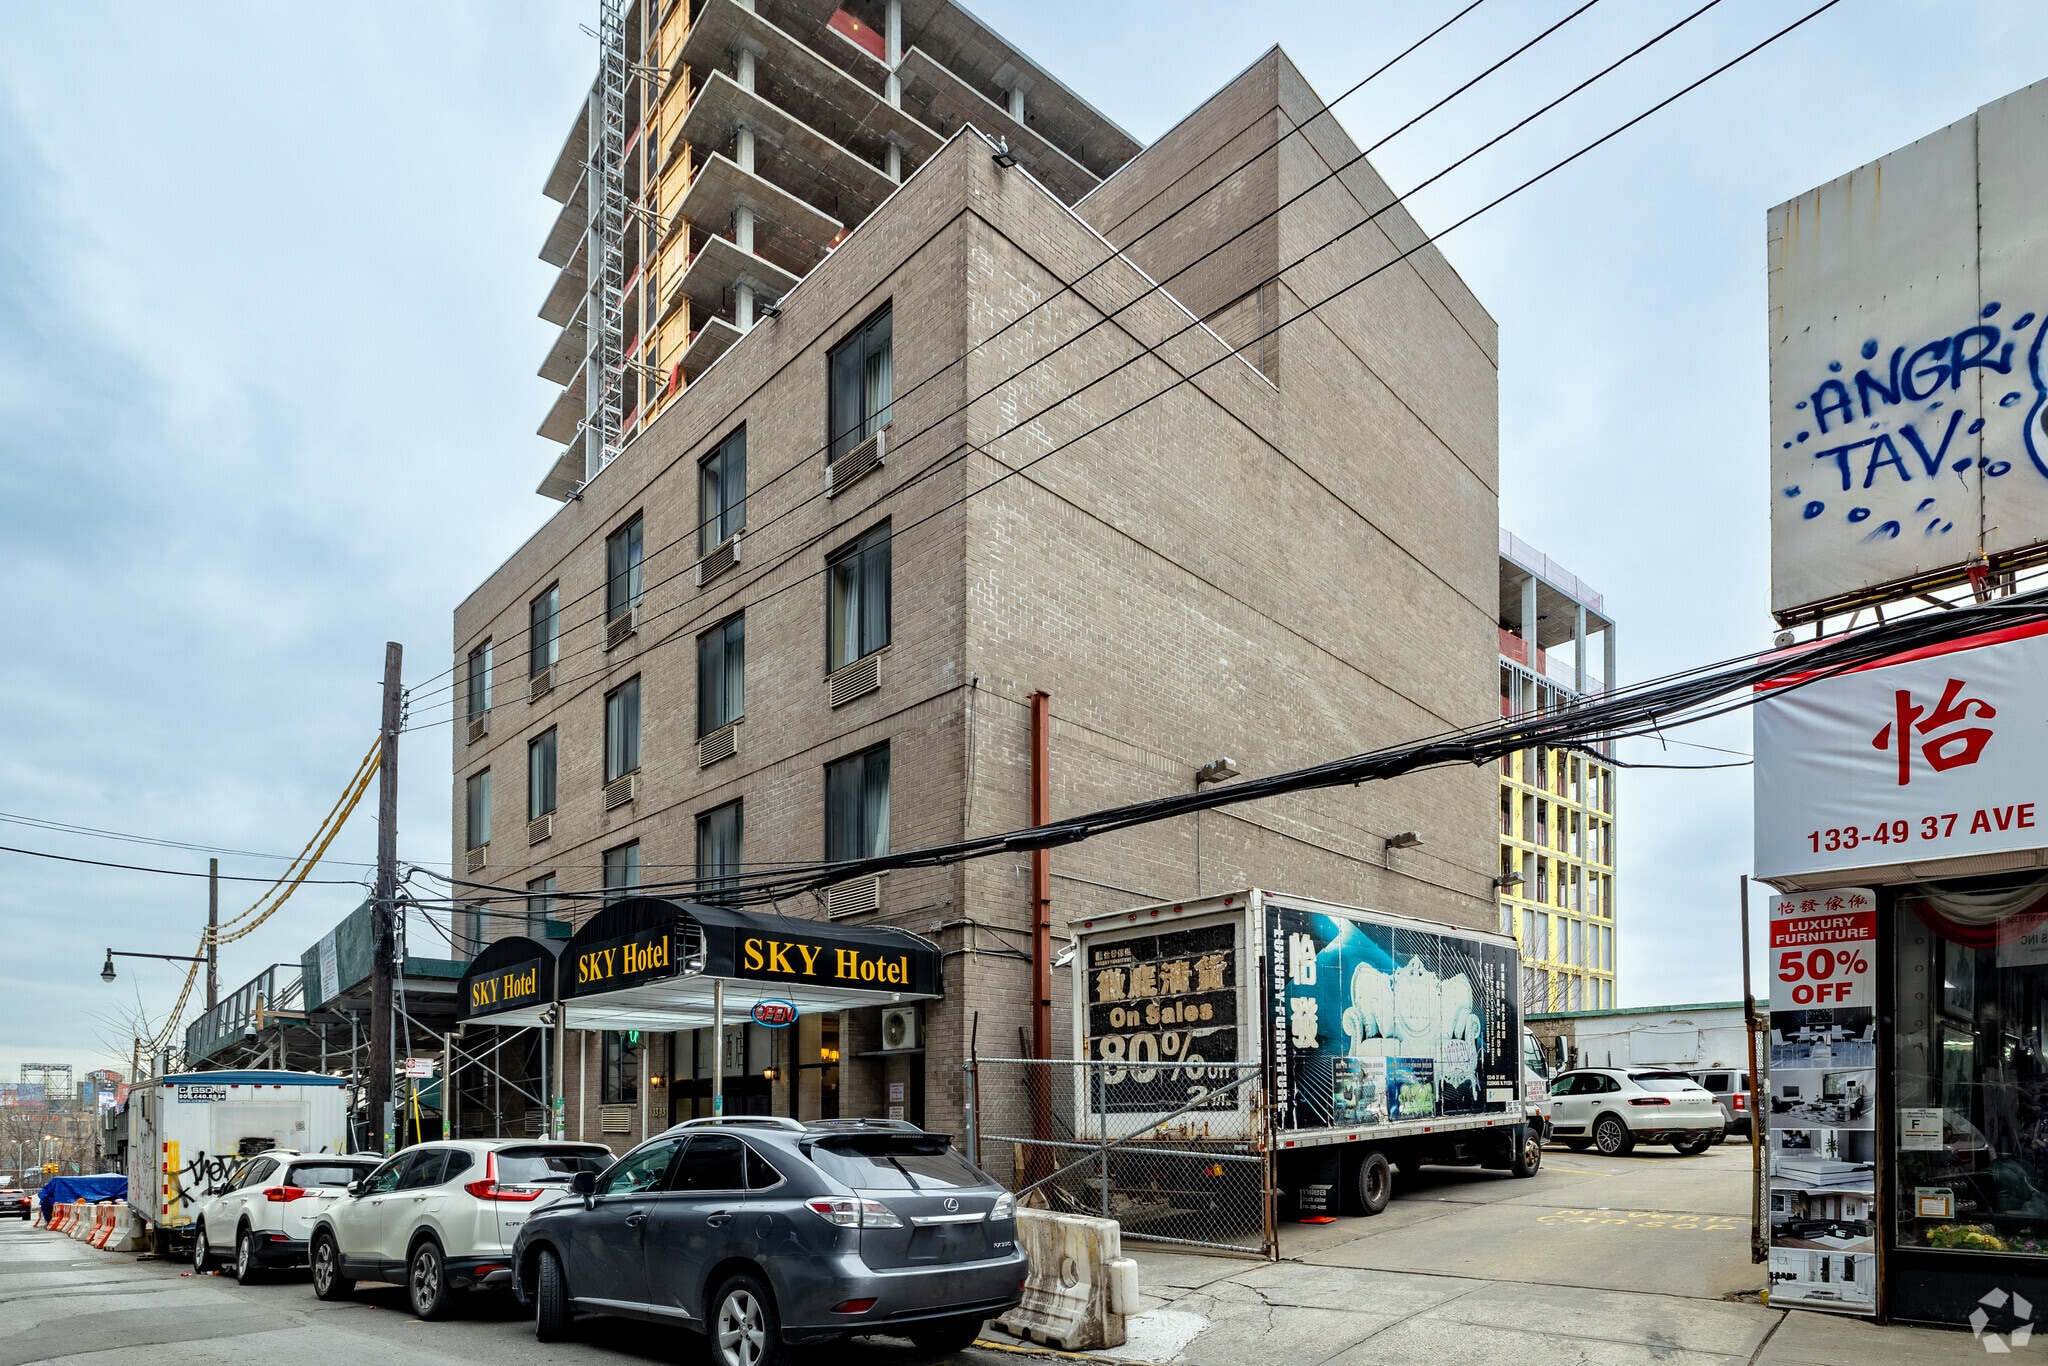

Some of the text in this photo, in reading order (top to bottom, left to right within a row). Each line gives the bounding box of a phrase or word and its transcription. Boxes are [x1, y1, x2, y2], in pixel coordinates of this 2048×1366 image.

[1815, 409, 1964, 491] TAV
[1871, 678, 1997, 787] 怡
[1807, 802, 2035, 853] 133-49 37 AVE
[1776, 928, 1869, 945] FURNITURE
[1789, 917, 1855, 932] LUXURY
[579, 935, 669, 984] SKY Hotel
[744, 938, 909, 985] SKY Hotel
[1777, 948, 1869, 983] 50%
[472, 968, 536, 1007] SKY Hotel
[1791, 982, 1853, 1004] OFF
[755, 1005, 795, 1022] OPEN
[1110, 1001, 1214, 1028] On Sales
[1273, 929, 1288, 1112] LUXURY FURNITURE
[1911, 1119, 1921, 1129] F
